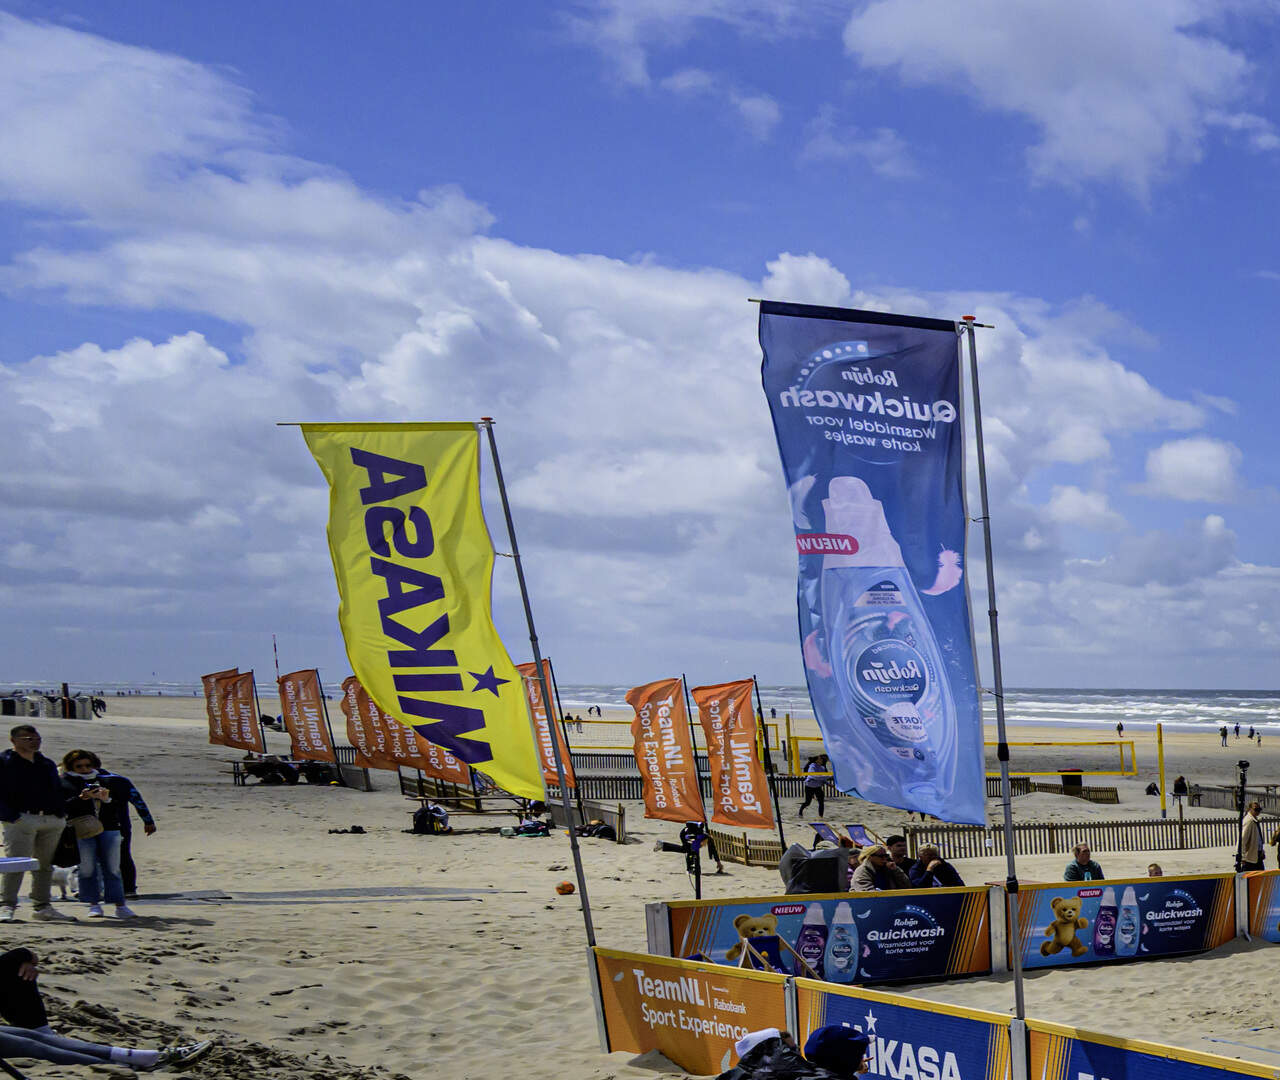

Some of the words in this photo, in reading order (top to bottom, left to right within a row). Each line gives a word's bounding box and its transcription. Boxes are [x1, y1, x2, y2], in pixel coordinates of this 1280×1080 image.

[640, 702, 653, 739] Sport
[656, 696, 685, 769] TeamNL
[642, 741, 667, 809] Experience
[1079, 889, 1101, 897] NIEUW
[774, 905, 804, 914] NIEUW
[1146, 908, 1203, 921] Quickwash
[894, 918, 919, 927] Robijn
[866, 926, 945, 942] Quickwash
[878, 940, 918, 949] Wasmiddel
[905, 946, 929, 954] wasjes
[632, 968, 705, 1007] TeamNL
[713, 997, 747, 1014] Rabobank
[641, 1002, 677, 1030] Sport
[678, 1009, 749, 1041] Experience
